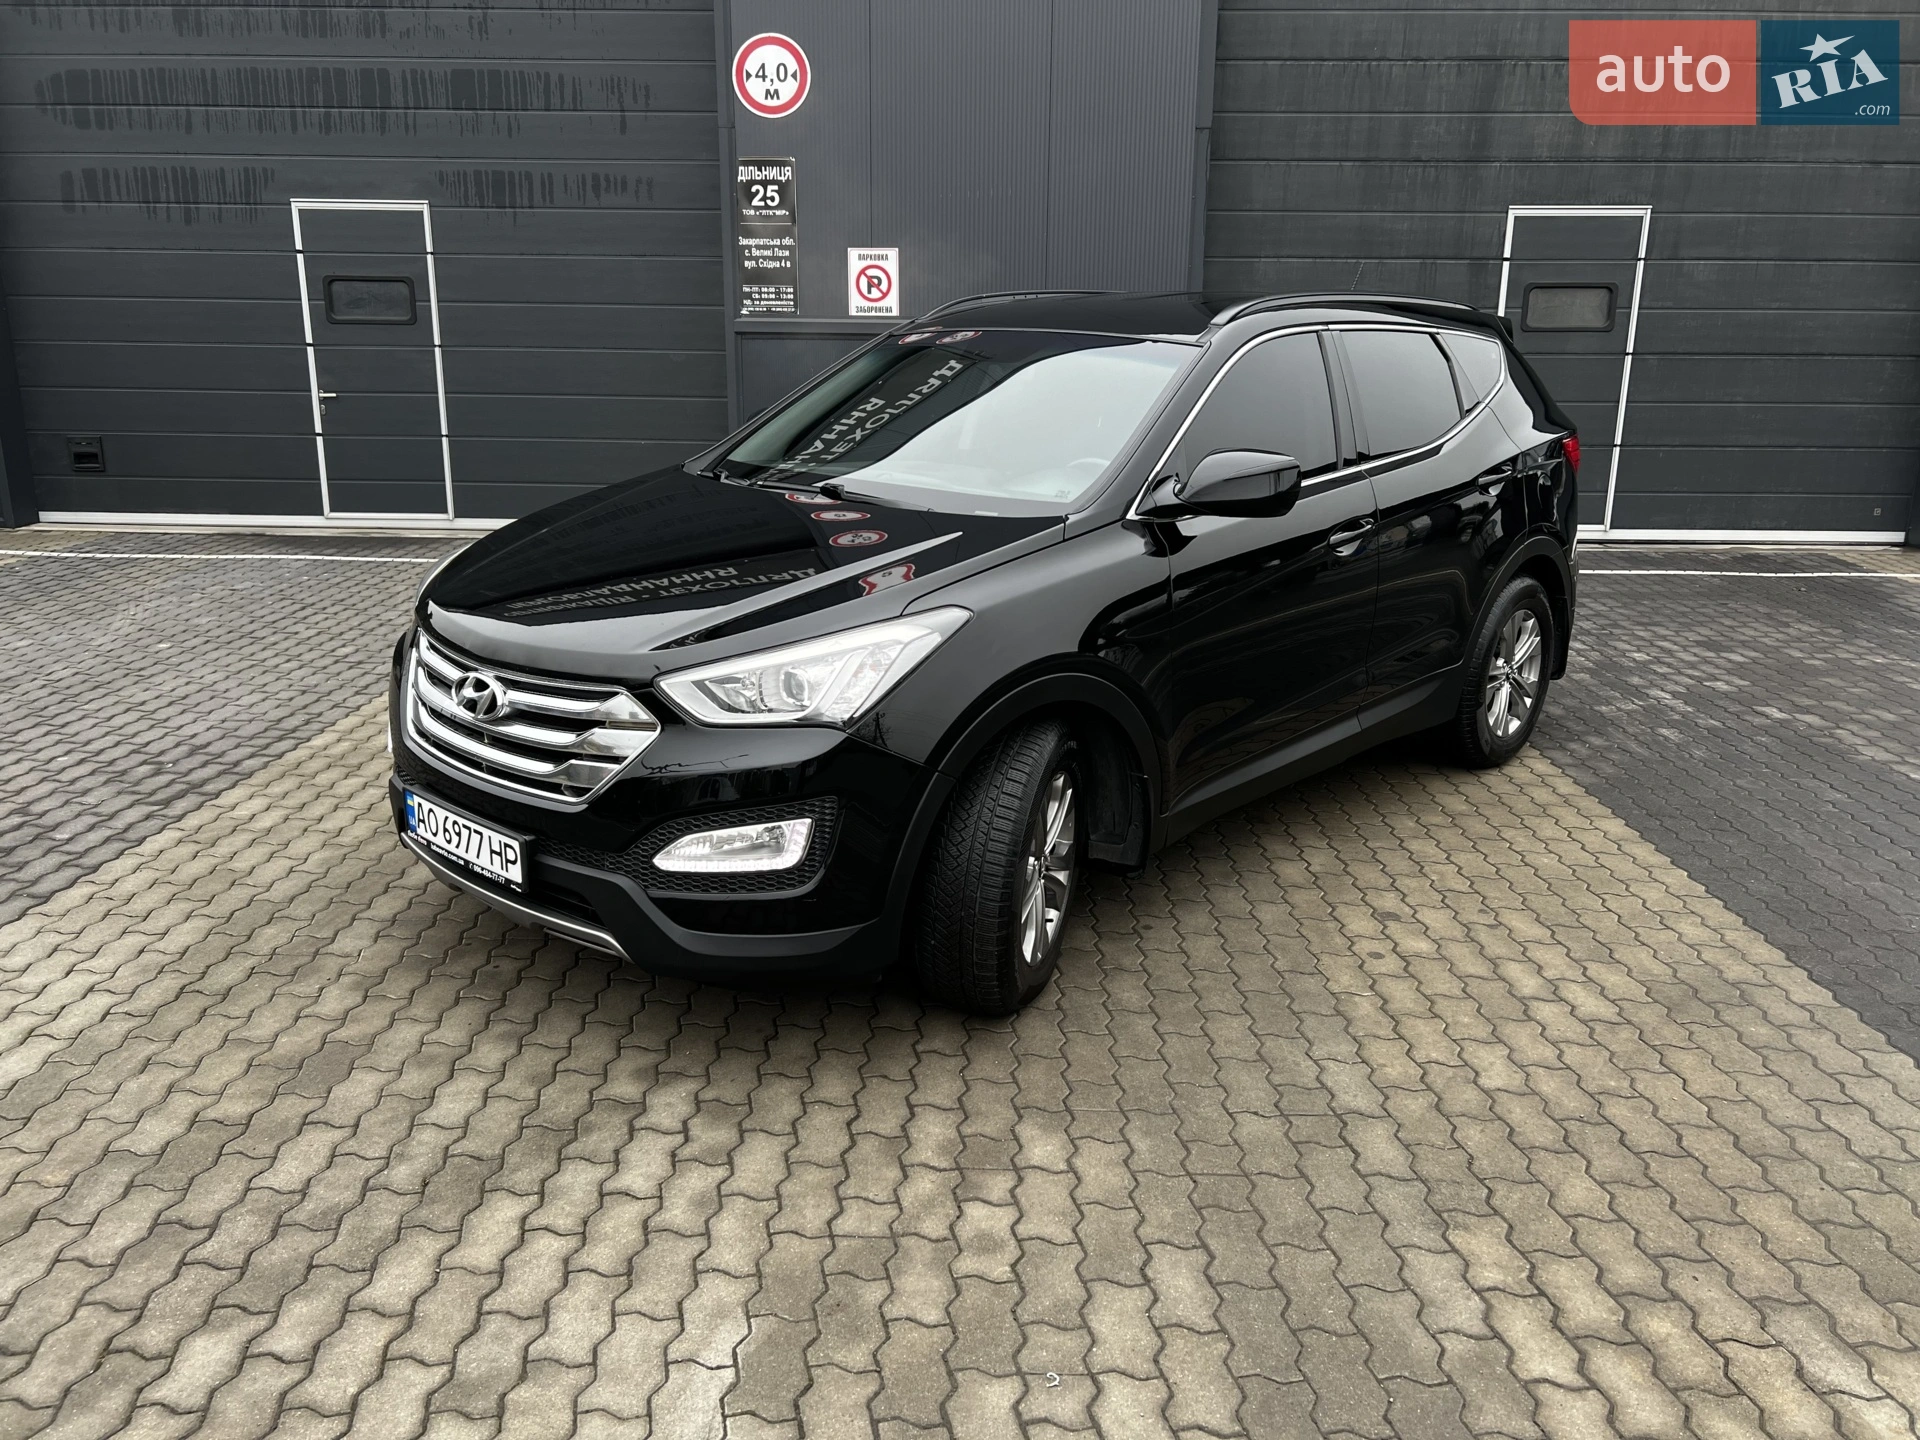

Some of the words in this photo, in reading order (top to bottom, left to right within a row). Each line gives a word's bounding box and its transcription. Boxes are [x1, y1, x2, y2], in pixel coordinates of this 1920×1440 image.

[755, 62, 788, 86] 4,0
[737, 165, 792, 183] ДІЛЬНИЦЯ
[750, 184, 780, 207] 25
[738, 236, 780, 247] Закарпатська
[781, 236, 796, 246] обл.
[751, 247, 773, 257] Великі
[773, 247, 790, 257] Лази
[857, 253, 889, 261] ПАРКОВКА
[744, 260, 758, 269] вул.
[758, 258, 780, 269] Східна
[855, 305, 893, 314] ЗАБОРОНЕНА
[408, 815, 416, 825] UA
[417, 801, 439, 838] AO
[442, 815, 484, 860] 6977
[488, 834, 519, 873] HP
